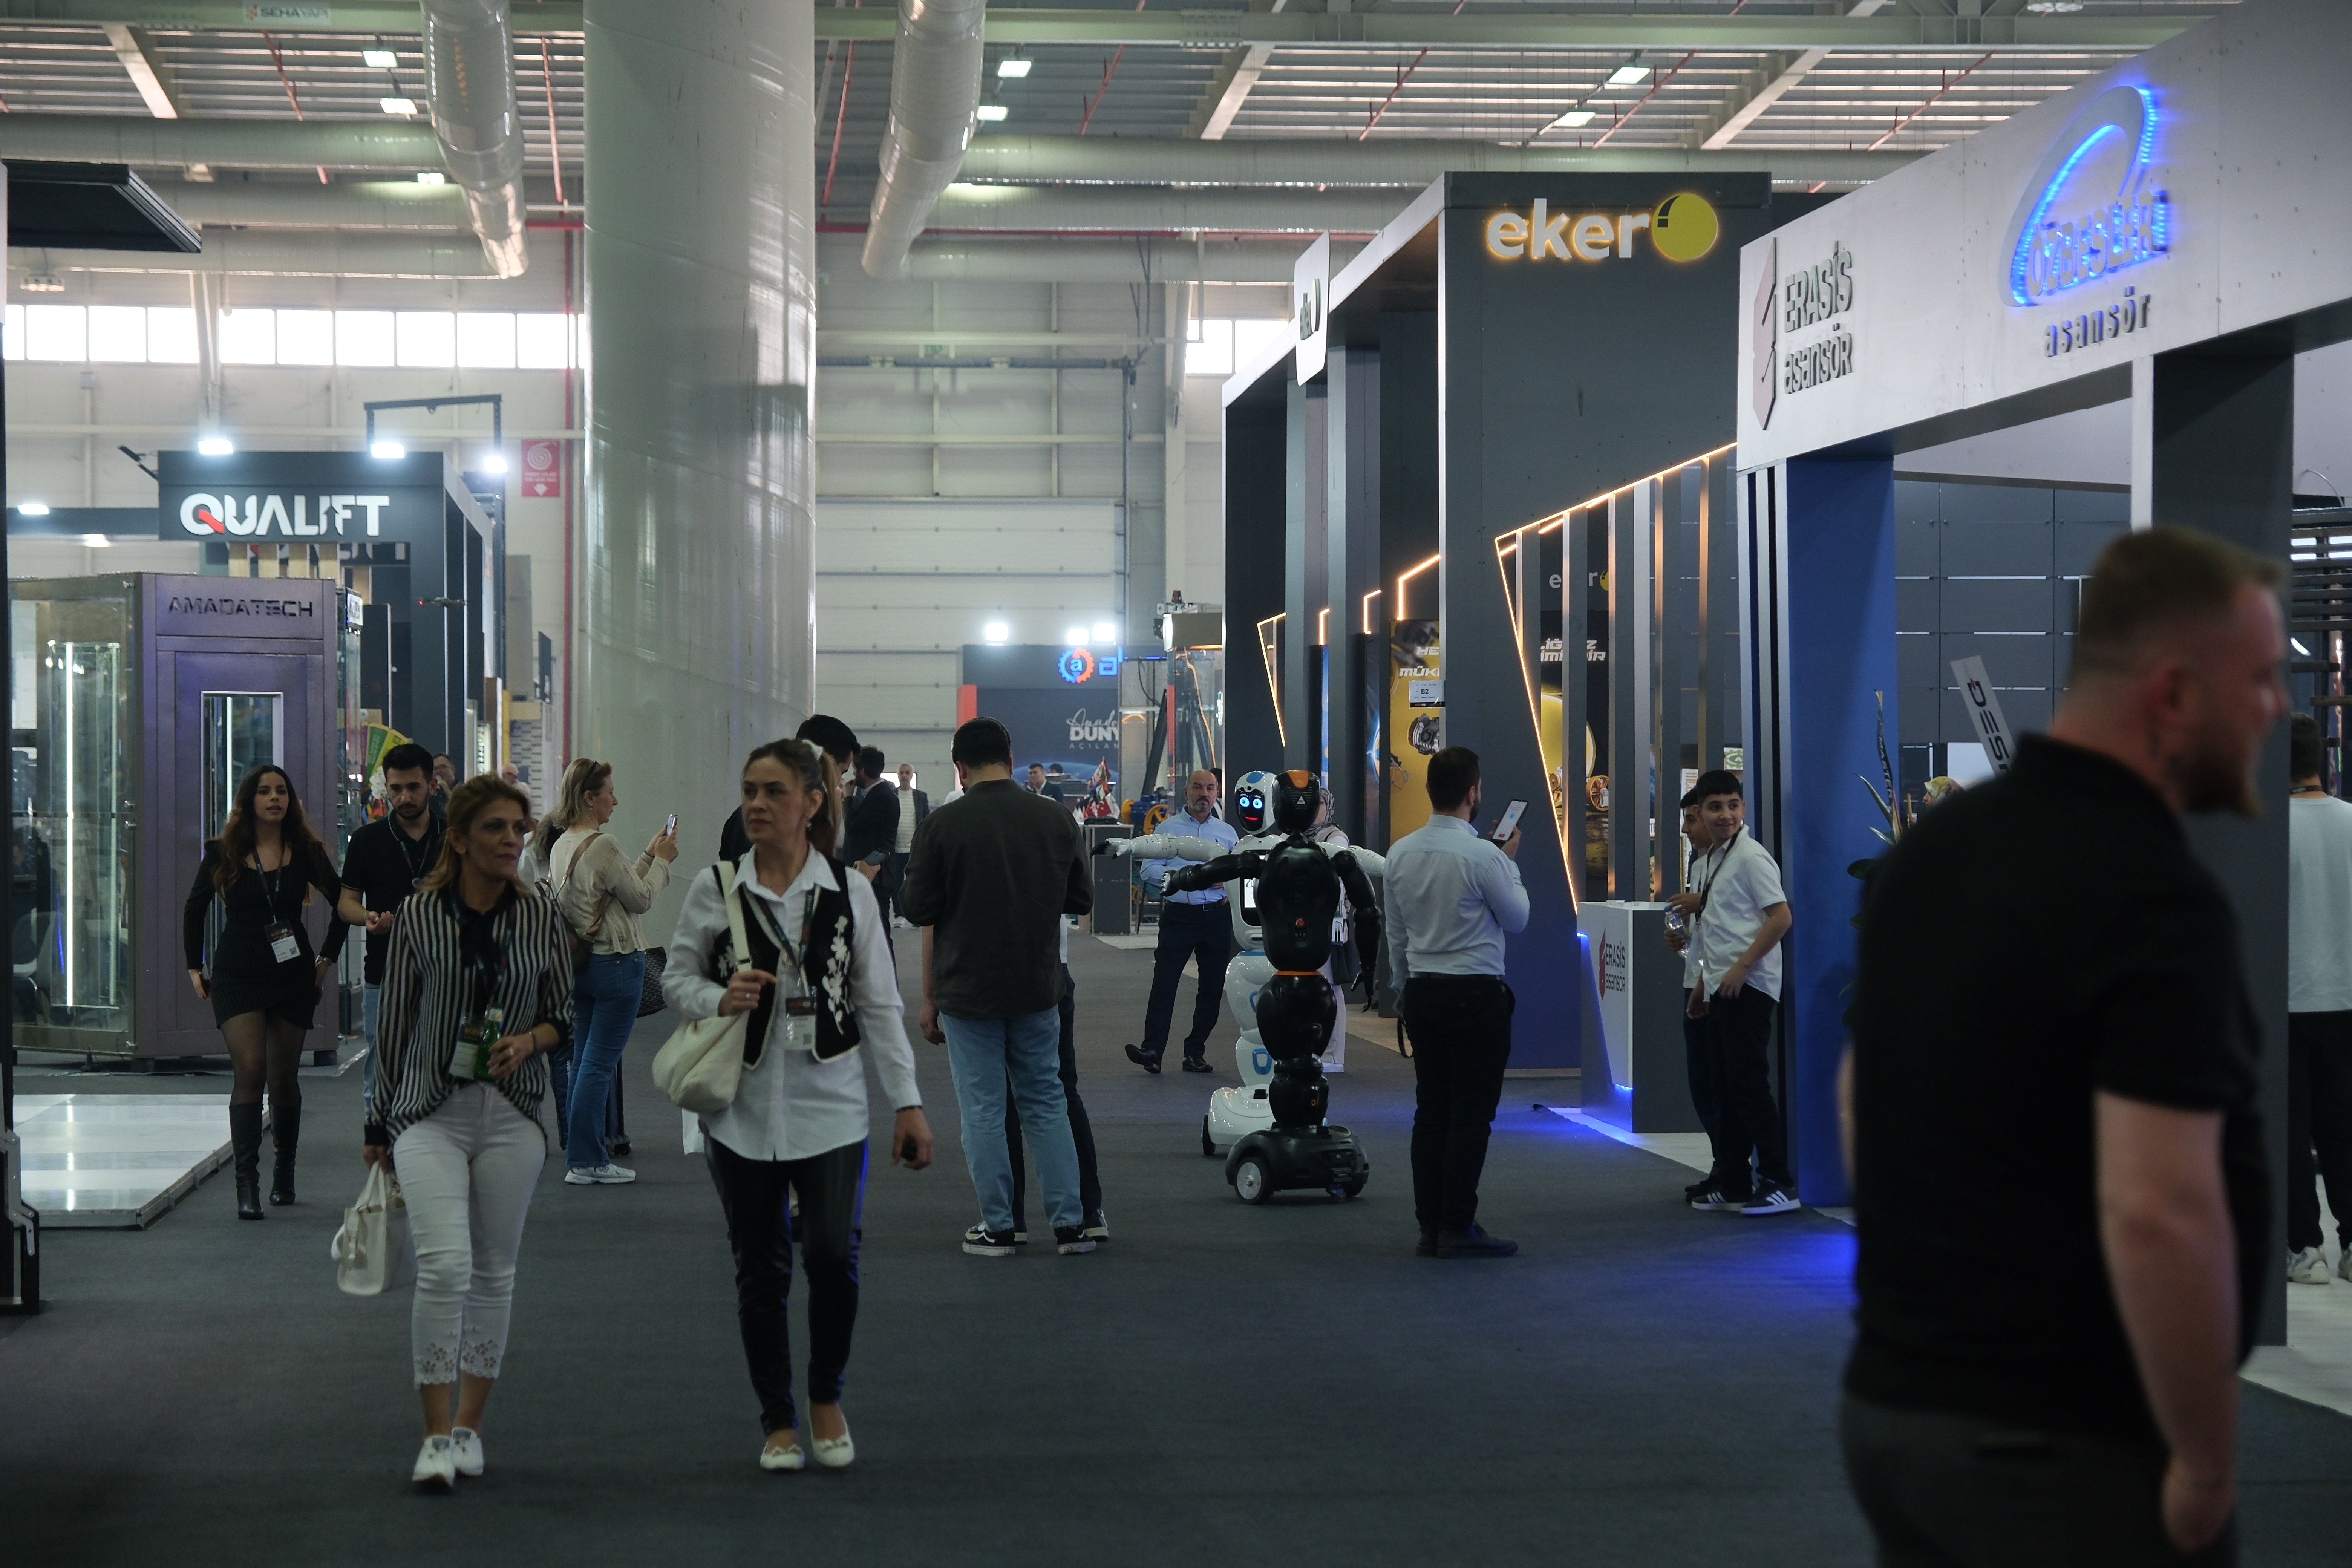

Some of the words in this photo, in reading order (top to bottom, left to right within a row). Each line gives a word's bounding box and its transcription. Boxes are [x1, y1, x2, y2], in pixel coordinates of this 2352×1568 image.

[1488, 198, 1649, 260] eker
[2044, 286, 2151, 357] asansör
[180, 493, 390, 536] QUALIFT
[168, 597, 312, 617] AMADATECH
